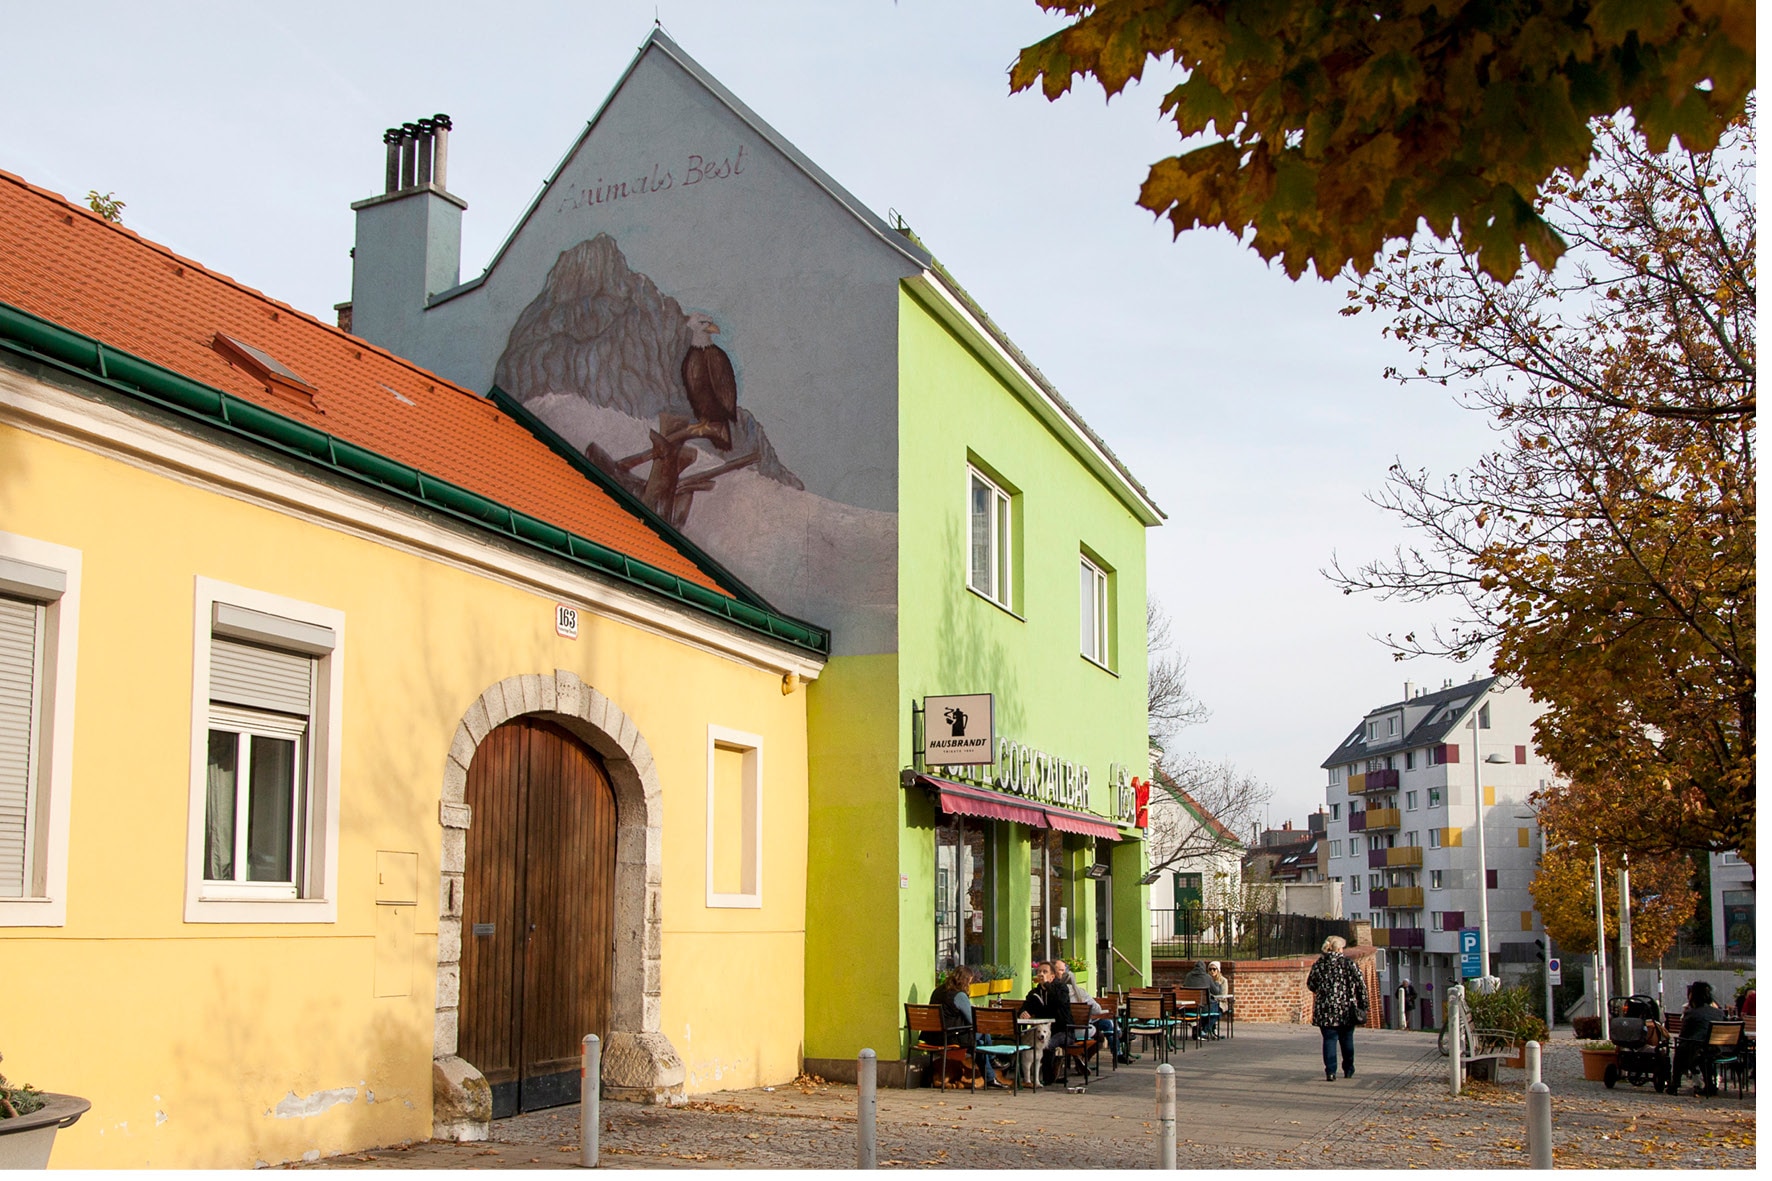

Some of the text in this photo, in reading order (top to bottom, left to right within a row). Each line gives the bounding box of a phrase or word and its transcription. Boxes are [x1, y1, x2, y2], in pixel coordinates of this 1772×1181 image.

[682, 145, 748, 186] Best
[559, 607, 576, 629] 163
[929, 738, 987, 748] HAUSBRANDT
[1000, 737, 1090, 809] COCKTAILBAR
[1464, 936, 1477, 952] P
